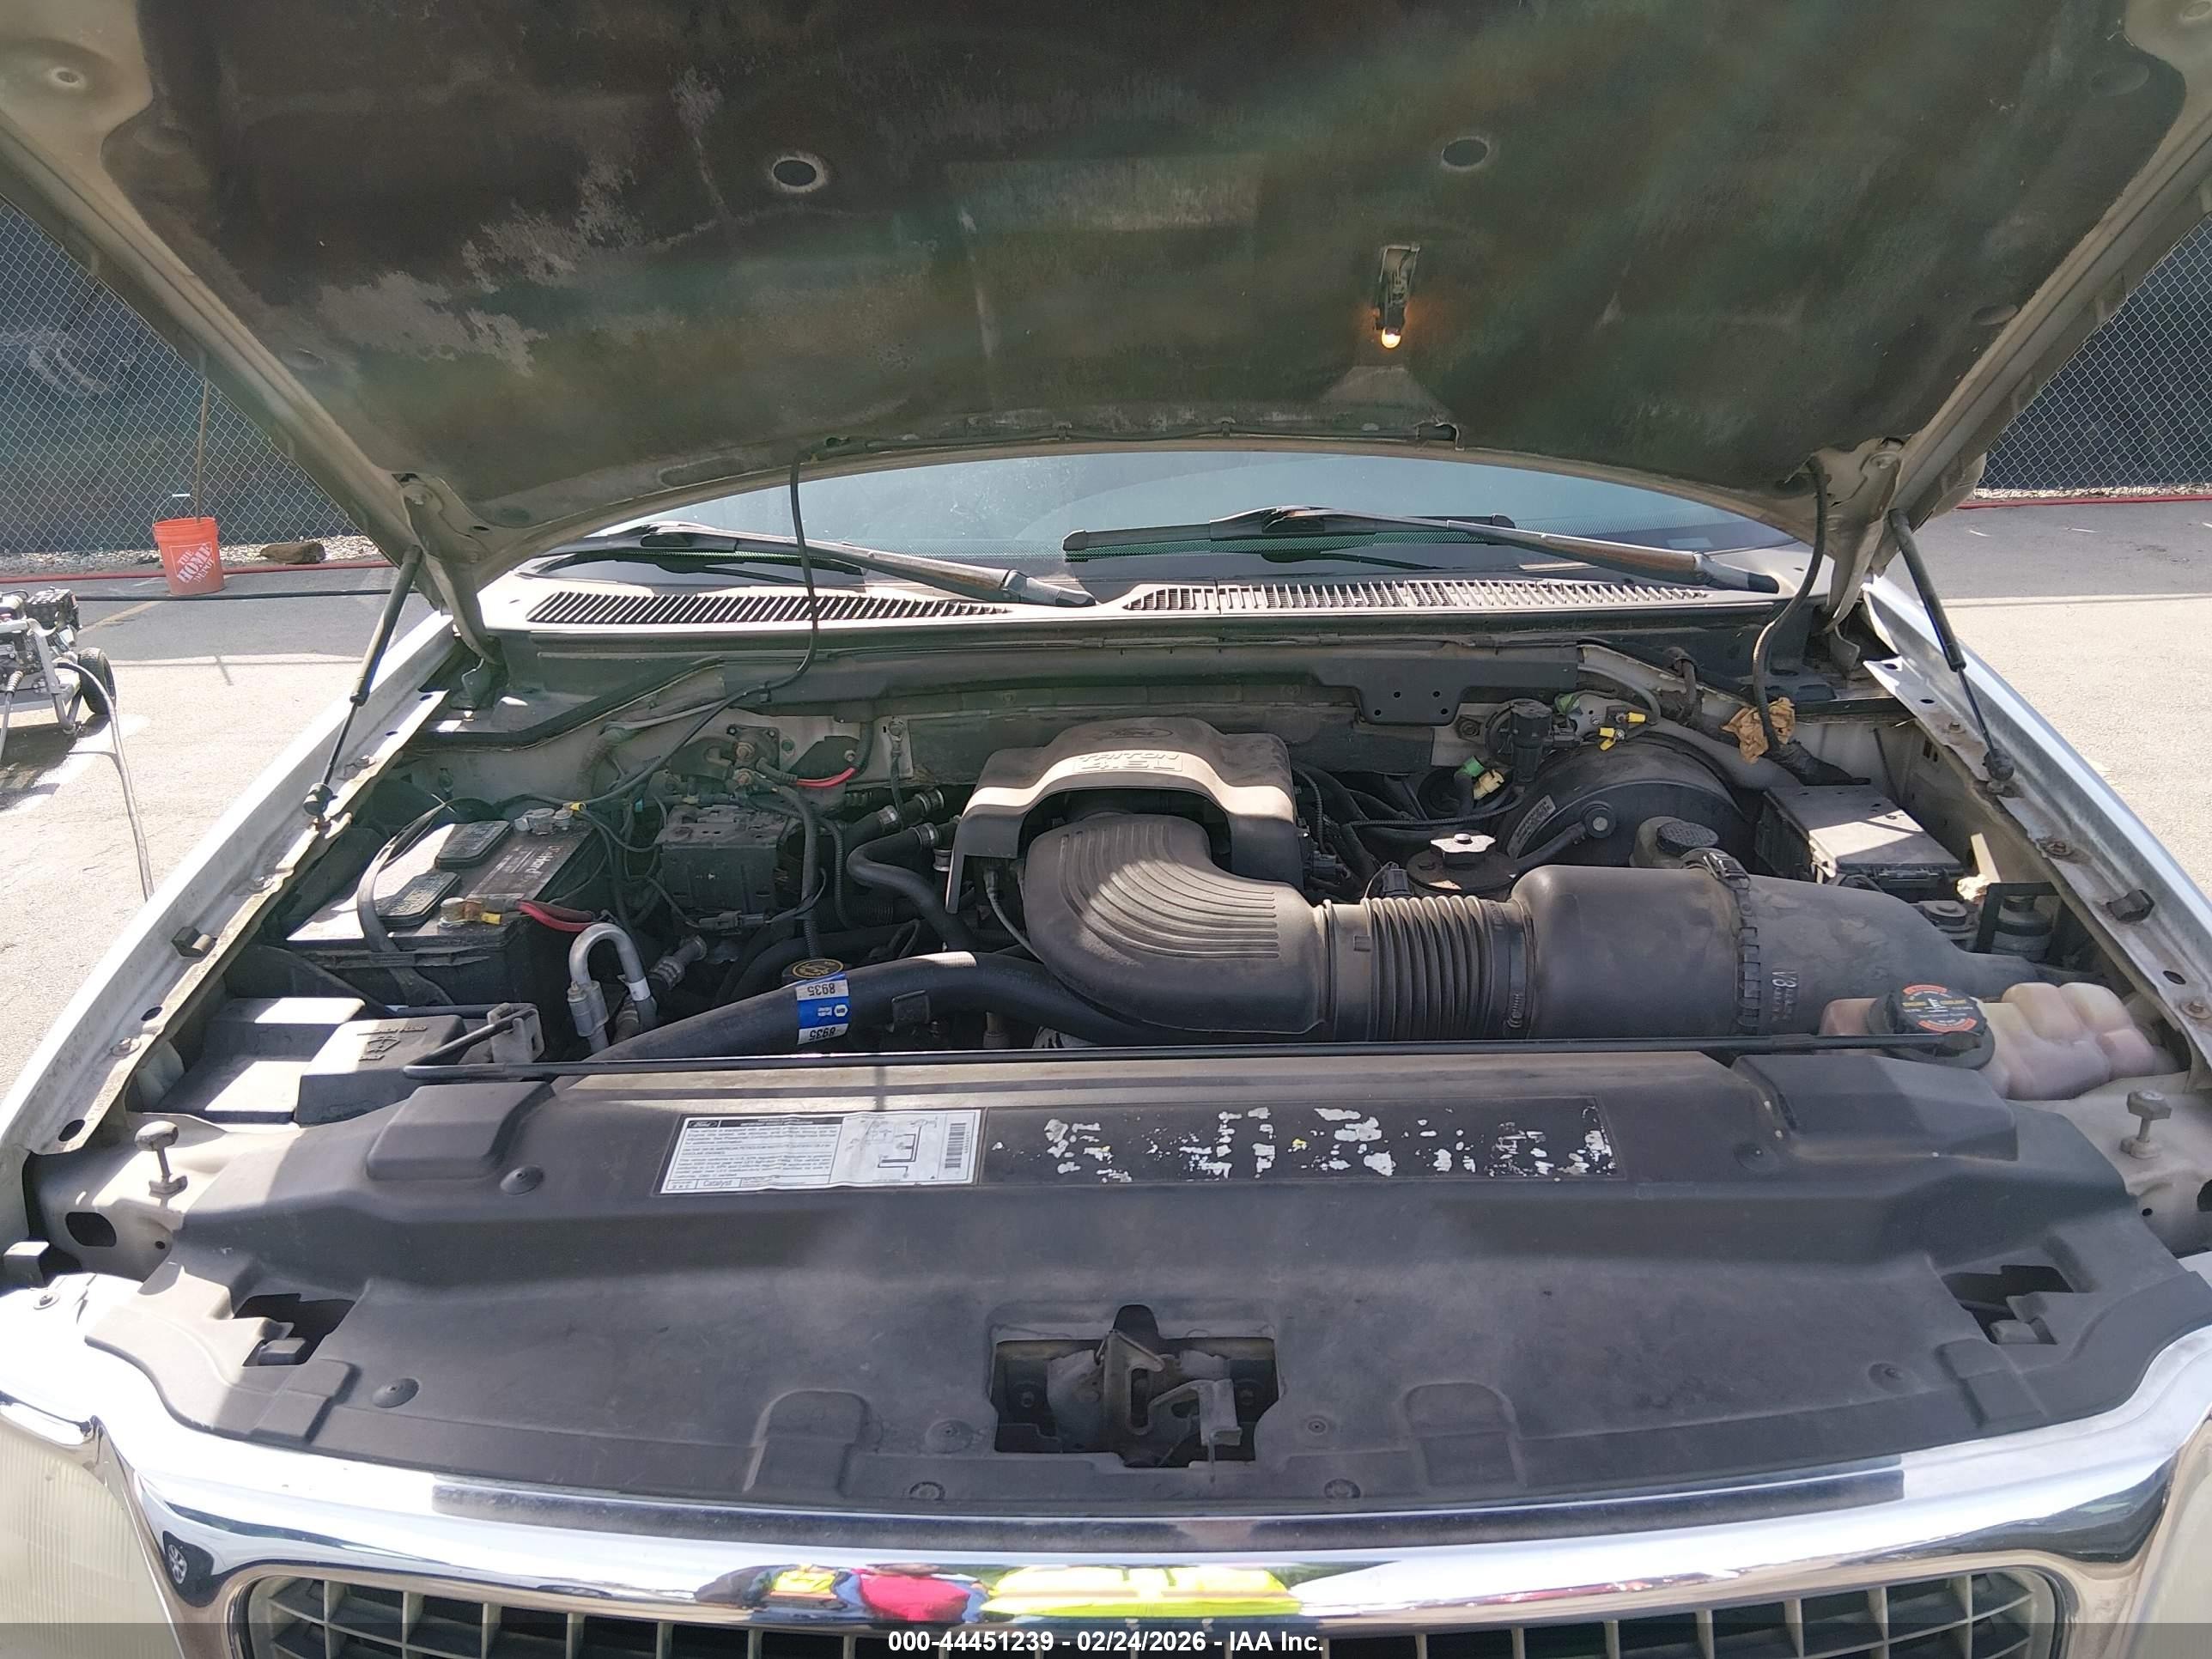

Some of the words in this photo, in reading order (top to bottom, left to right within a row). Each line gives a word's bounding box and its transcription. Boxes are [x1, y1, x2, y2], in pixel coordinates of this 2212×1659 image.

[177, 549, 194, 565] THE
[177, 543, 211, 583] HOME
[192, 558, 214, 583] DEPOT
[807, 982, 836, 996] 8935
[809, 1026, 836, 1041] 8935
[702, 1180, 733, 1188] Catalyst
